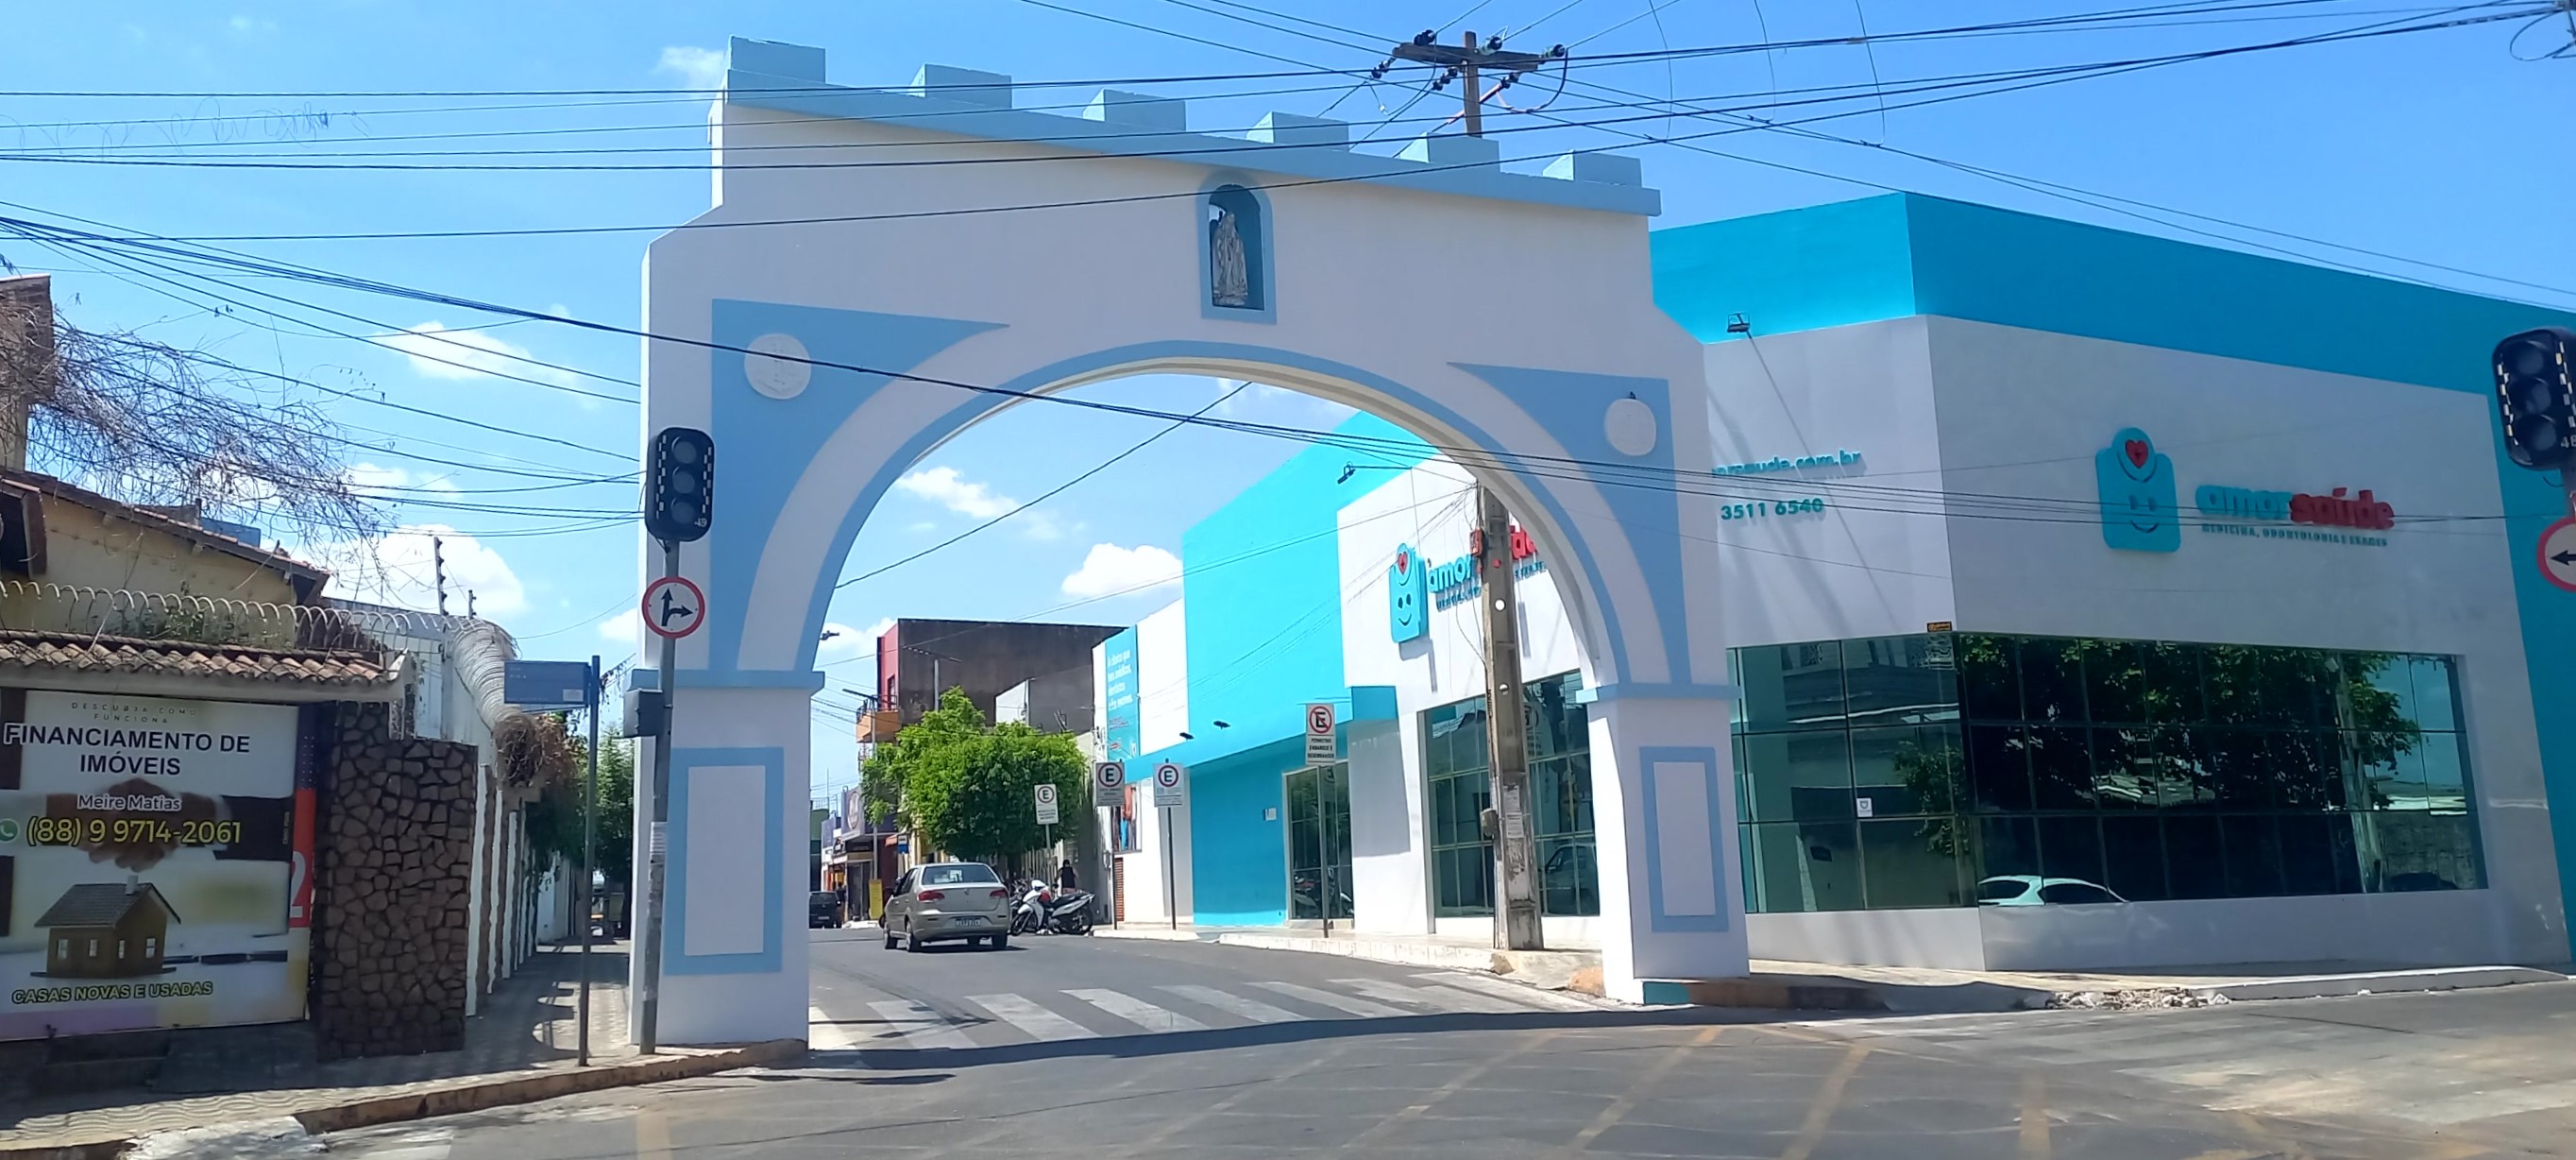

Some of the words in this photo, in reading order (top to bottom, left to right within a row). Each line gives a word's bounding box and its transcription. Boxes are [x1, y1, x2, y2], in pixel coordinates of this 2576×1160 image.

[1720, 503, 1766, 520] 3511
[1774, 498, 1823, 516] 6540
[2195, 485, 2395, 530] amorsaúde
[93, 713, 168, 724] FUNCIONA
[4, 724, 212, 752] FINANCIAMENTO
[220, 735, 250, 753] DE
[80, 751, 180, 776] IMÓVEIS
[1105, 767, 1115, 783] E
[1163, 770, 1173, 783] E
[77, 793, 127, 811] Meire
[128, 794, 181, 811] Matias
[1042, 789, 1050, 800] E
[26, 816, 83, 846] (88)
[89, 819, 106, 844] 9
[112, 820, 242, 844] 9714-2061
[12, 987, 72, 1004] CASAS
[74, 985, 130, 1001] NOVAS
[133, 984, 145, 998] E
[148, 981, 213, 998] USADAS
